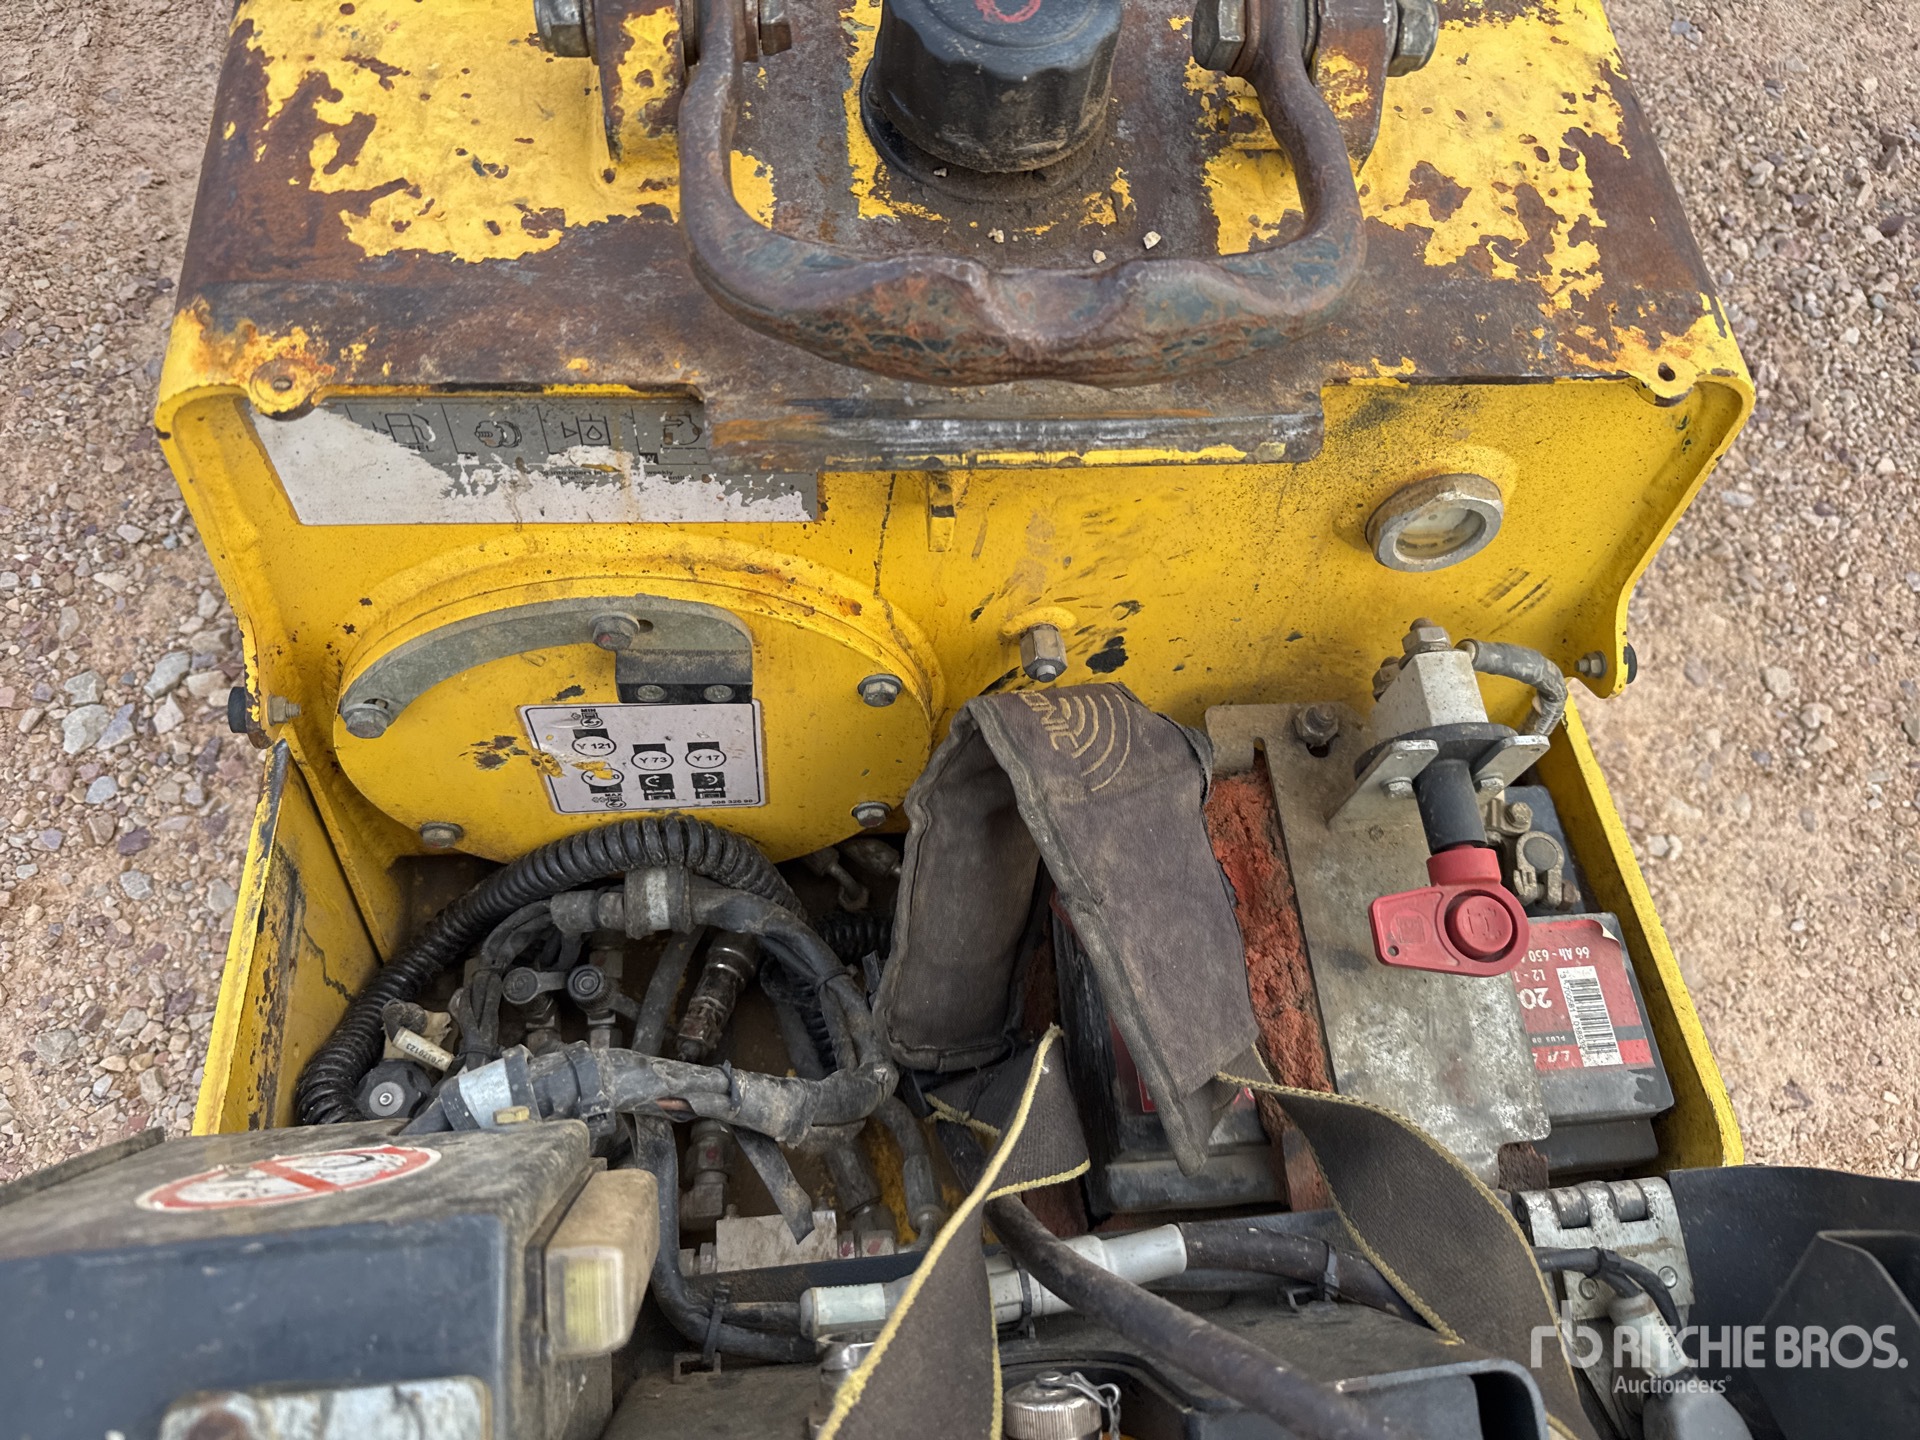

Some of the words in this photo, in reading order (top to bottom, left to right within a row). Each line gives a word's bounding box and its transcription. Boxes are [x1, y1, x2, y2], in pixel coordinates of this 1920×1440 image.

[1528, 949, 1549, 963] 650
[1558, 947, 1573, 961] Ah
[1575, 946, 1591, 960] 66
[1531, 969, 1546, 981] L2
